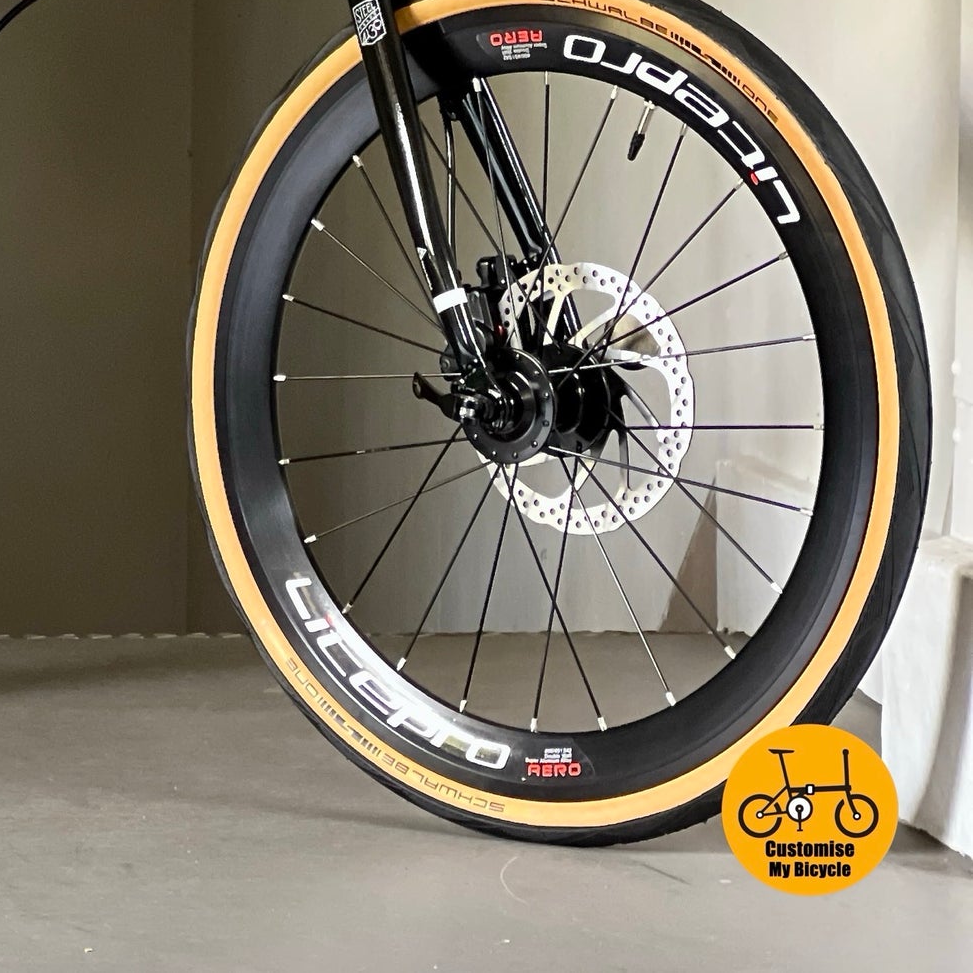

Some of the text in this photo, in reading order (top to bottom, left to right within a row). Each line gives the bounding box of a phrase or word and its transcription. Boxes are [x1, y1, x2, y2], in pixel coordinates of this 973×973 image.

[489, 30, 543, 47] AERO
[527, 762, 582, 777] AERO
[382, 753, 505, 813] SCHWALBE
